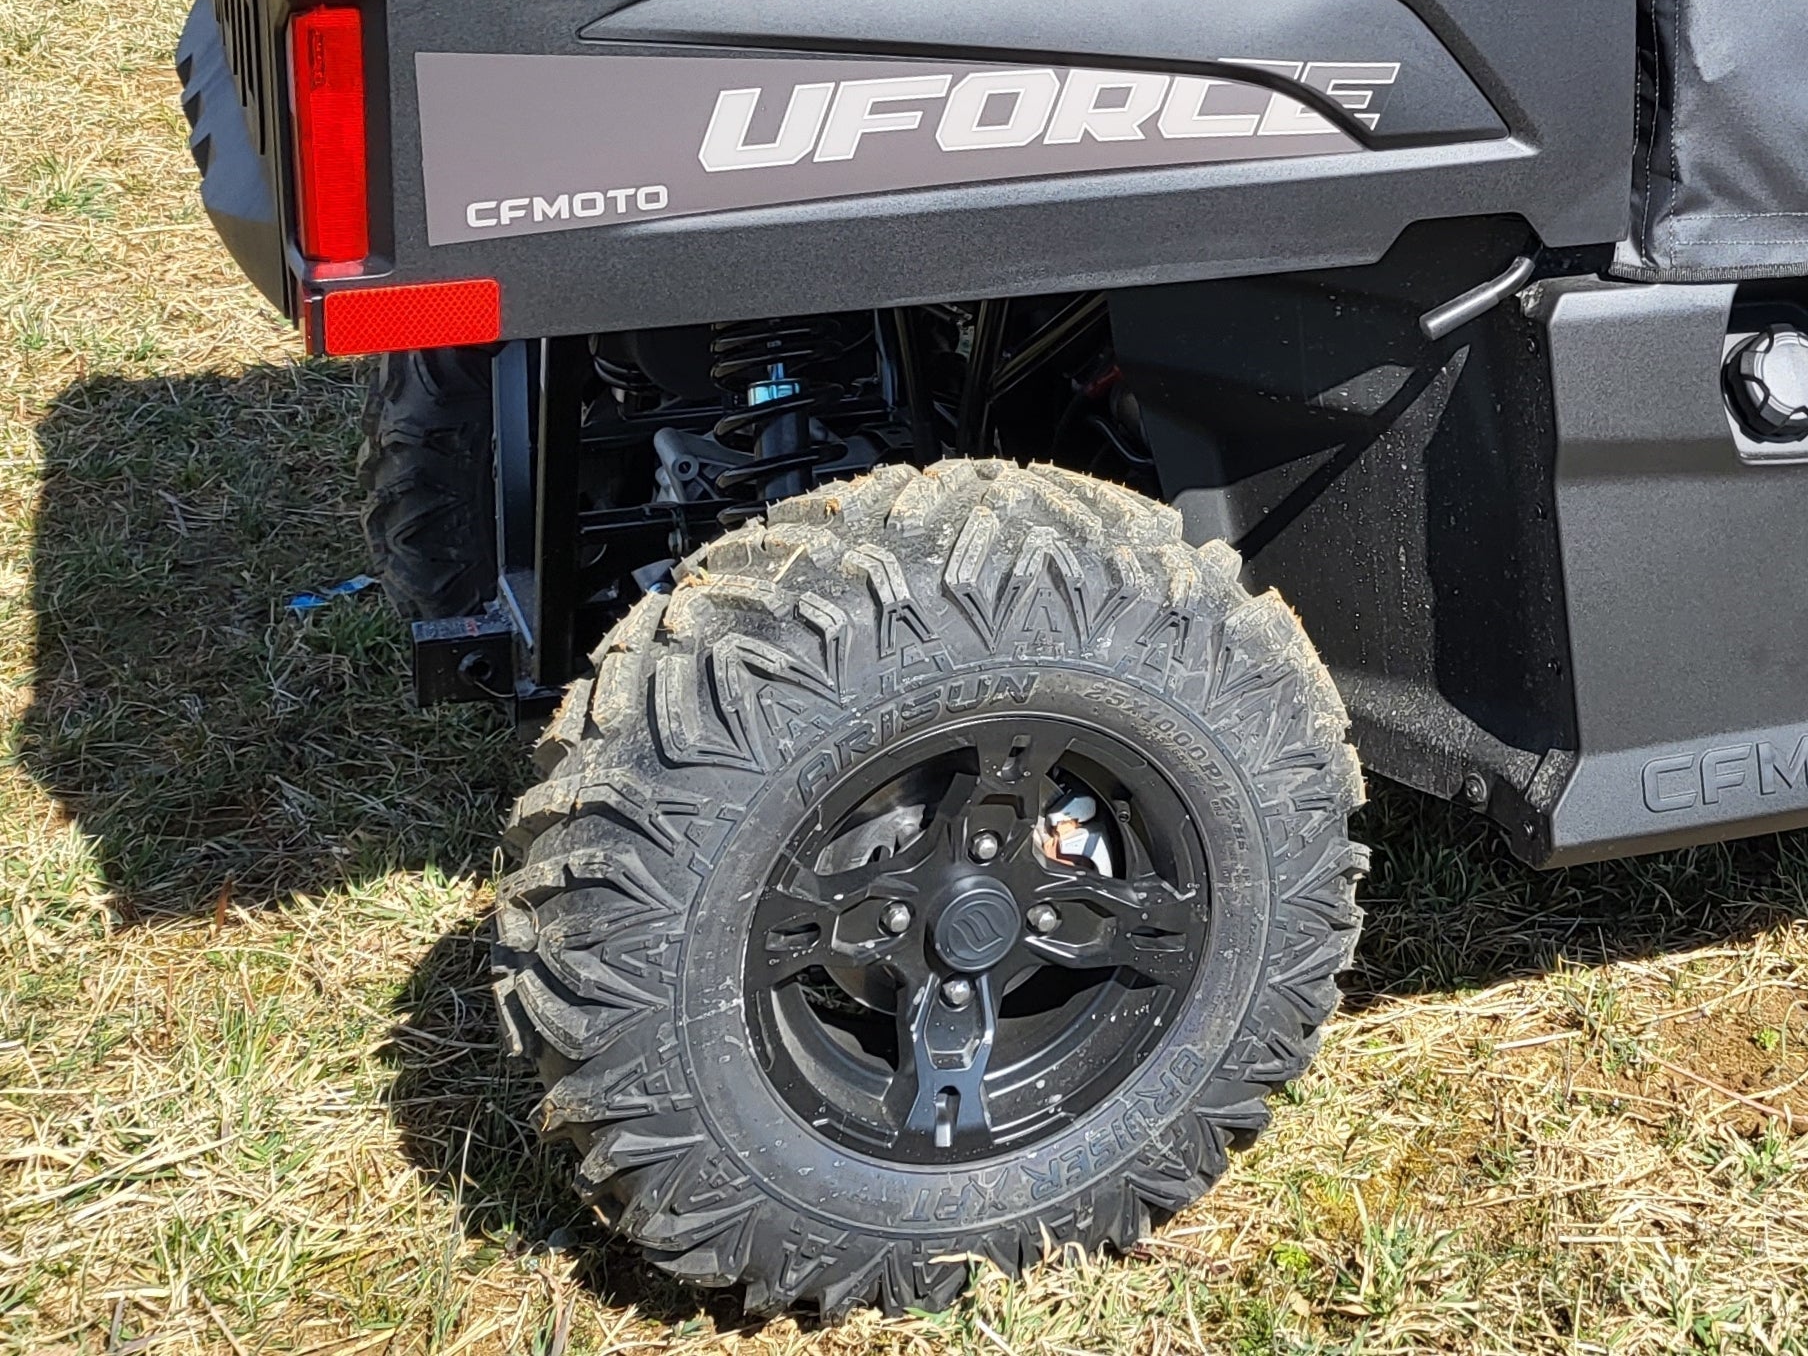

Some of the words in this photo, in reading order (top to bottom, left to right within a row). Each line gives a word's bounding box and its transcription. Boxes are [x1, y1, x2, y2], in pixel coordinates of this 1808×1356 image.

[697, 57, 1401, 174] UFORCE
[465, 184, 669, 229] CFMOTO
[796, 671, 1041, 808] ARISUN
[1019, 1044, 1203, 1202] BRUISER
